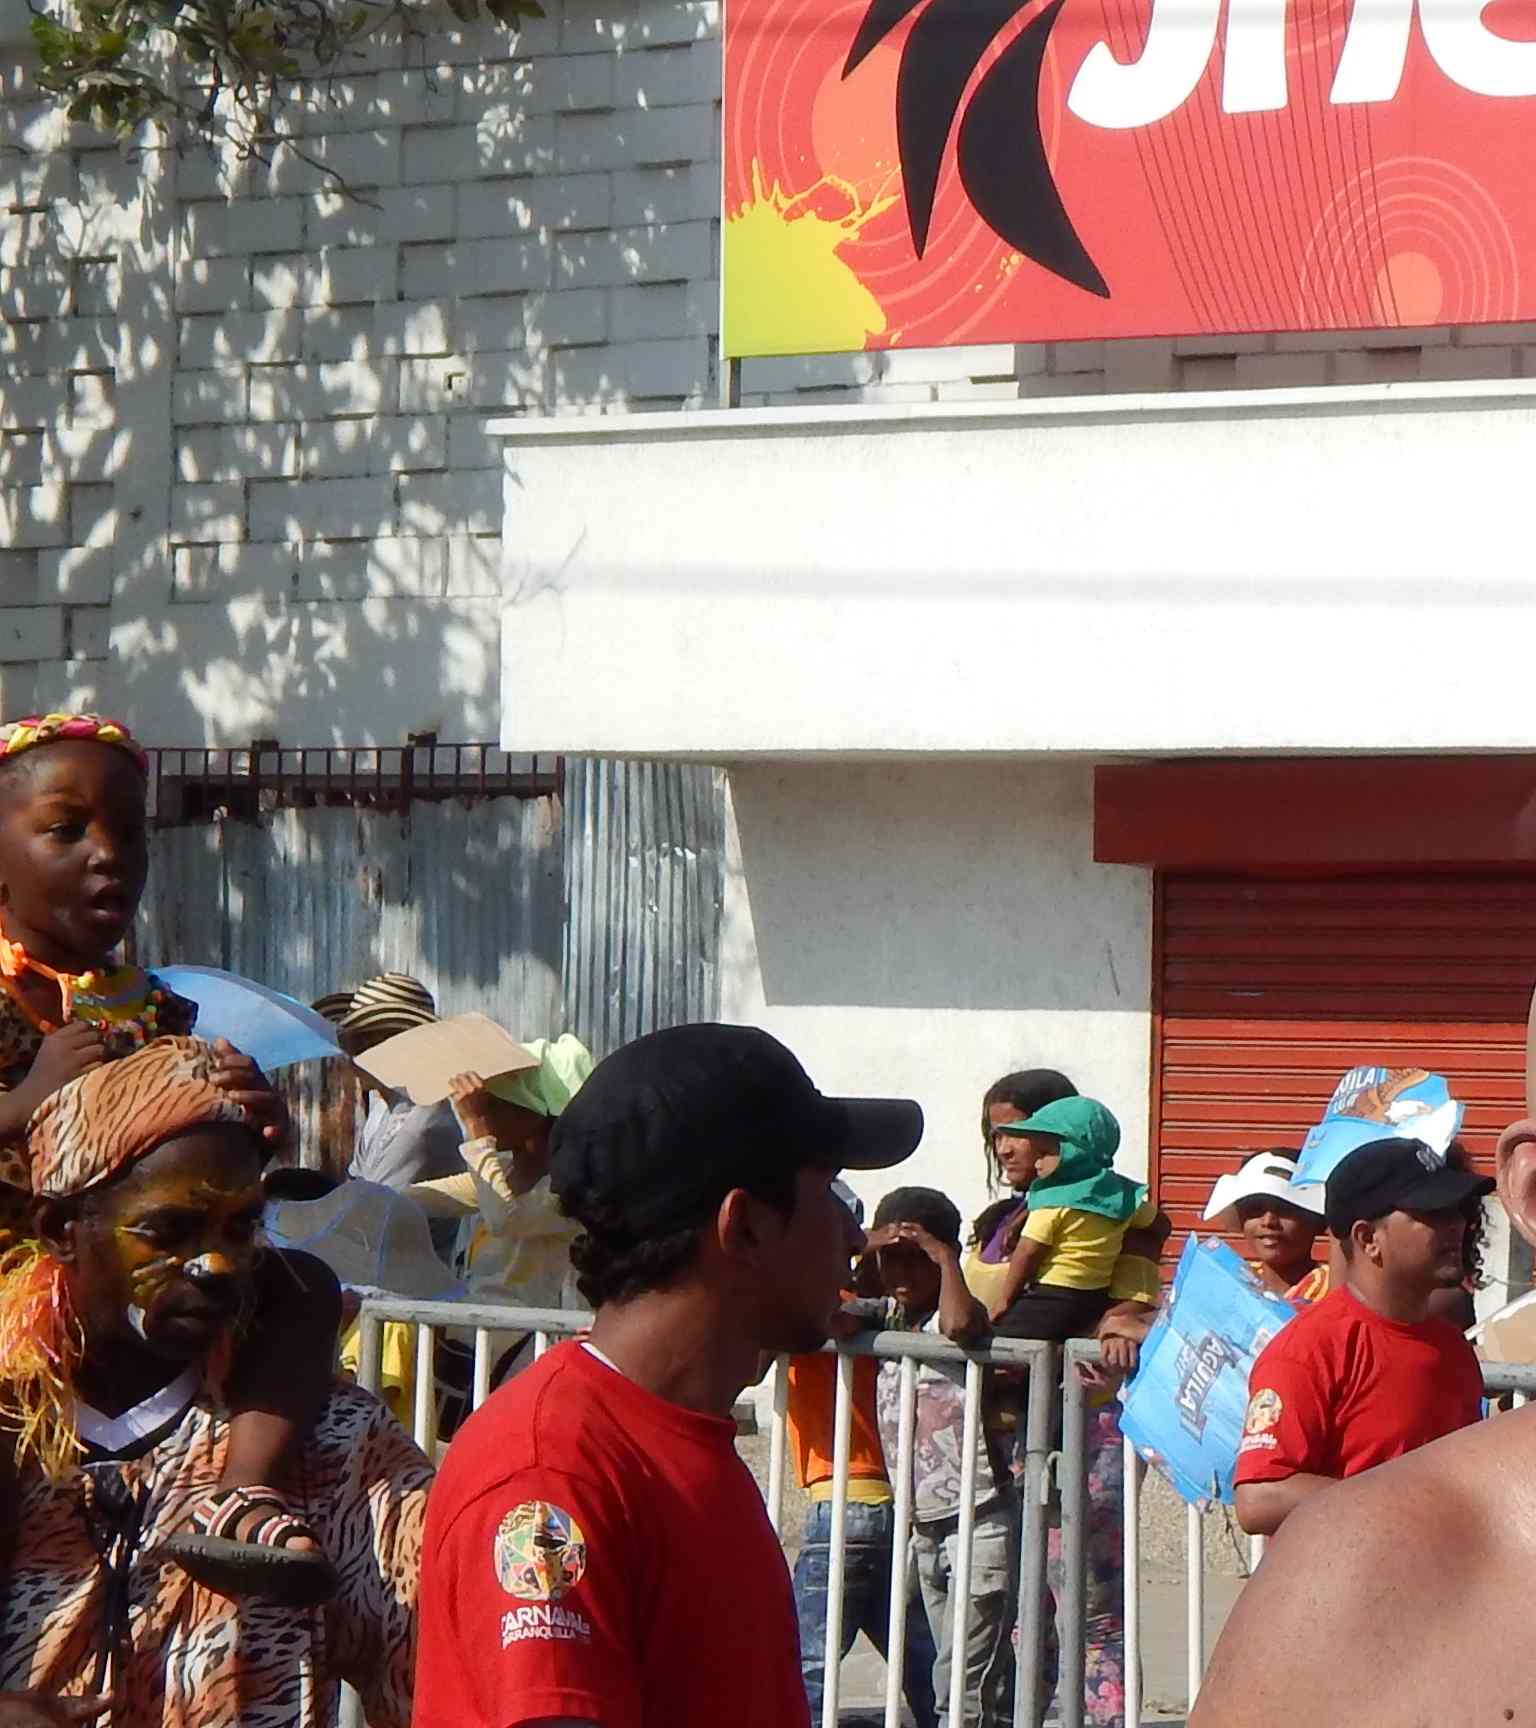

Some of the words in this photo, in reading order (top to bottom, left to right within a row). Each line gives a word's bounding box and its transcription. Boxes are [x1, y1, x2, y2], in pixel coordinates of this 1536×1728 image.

[1179, 1337, 1225, 1411] AGUILA
[501, 1604, 584, 1633] ARNAVAL
[502, 1625, 577, 1650] ARRANQUILLA
